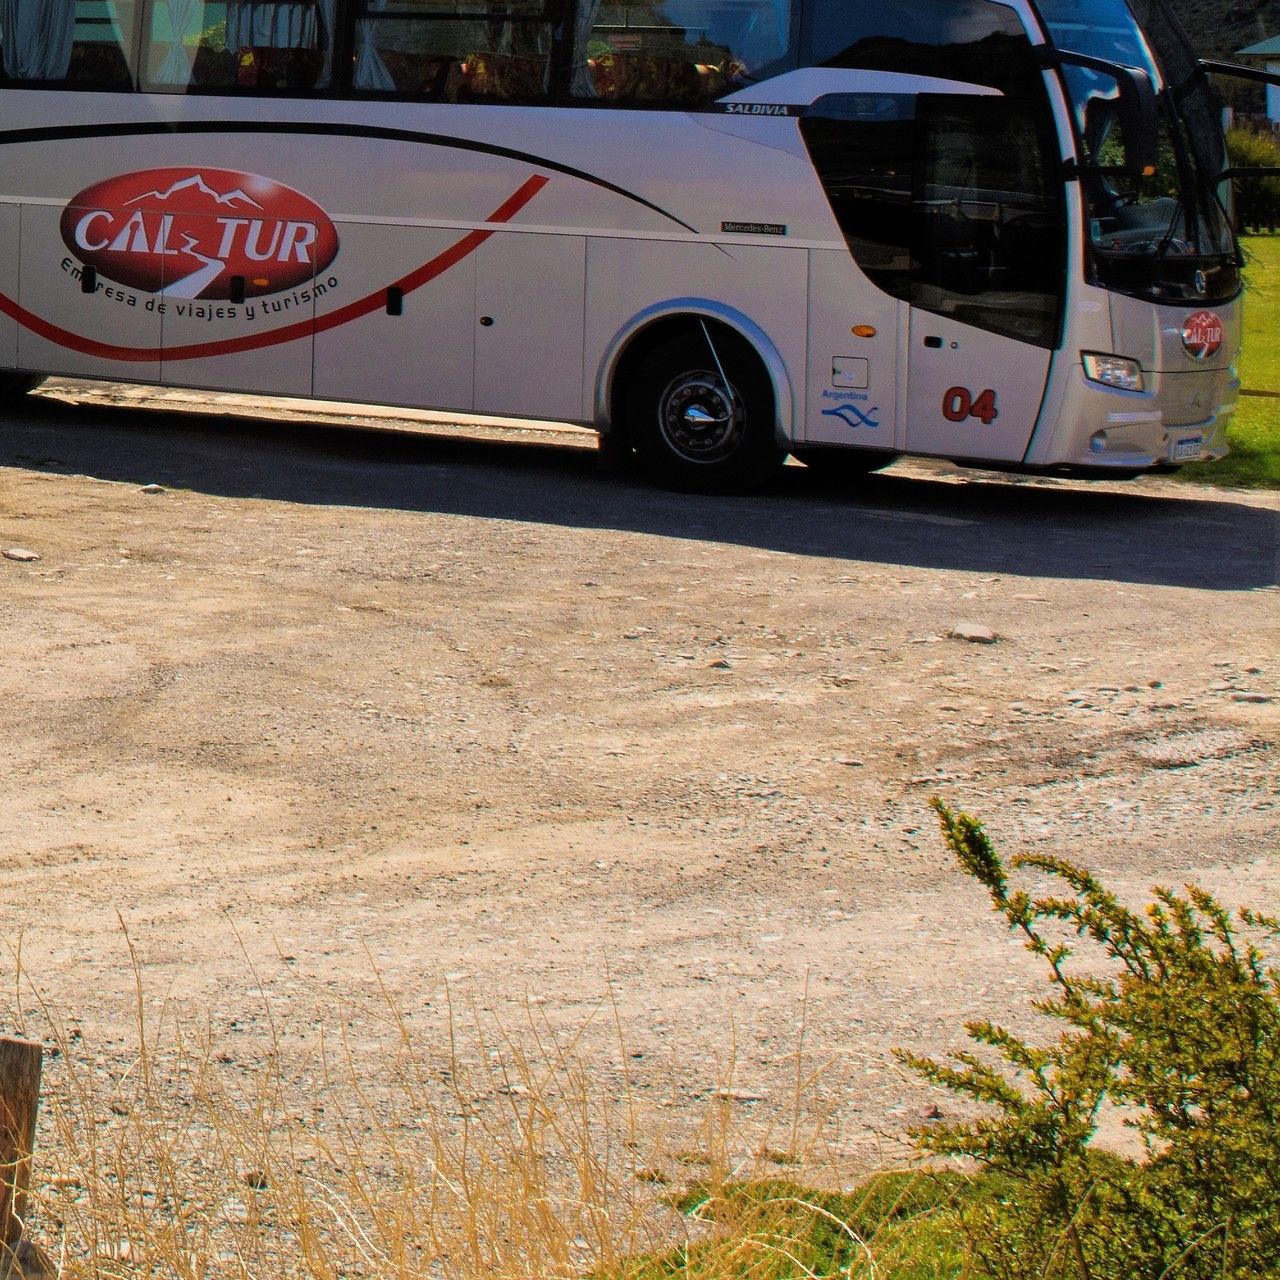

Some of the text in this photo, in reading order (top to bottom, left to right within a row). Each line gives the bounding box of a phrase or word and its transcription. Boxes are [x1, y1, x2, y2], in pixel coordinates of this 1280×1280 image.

[725, 103, 788, 115] SALDIVIA
[217, 217, 319, 263] TUR
[724, 222, 784, 234] Mercedes-Benz
[60, 257, 338, 322] Emresa de viajes y turismo
[822, 389, 869, 401] Argentina
[942, 386, 998, 424] 04
